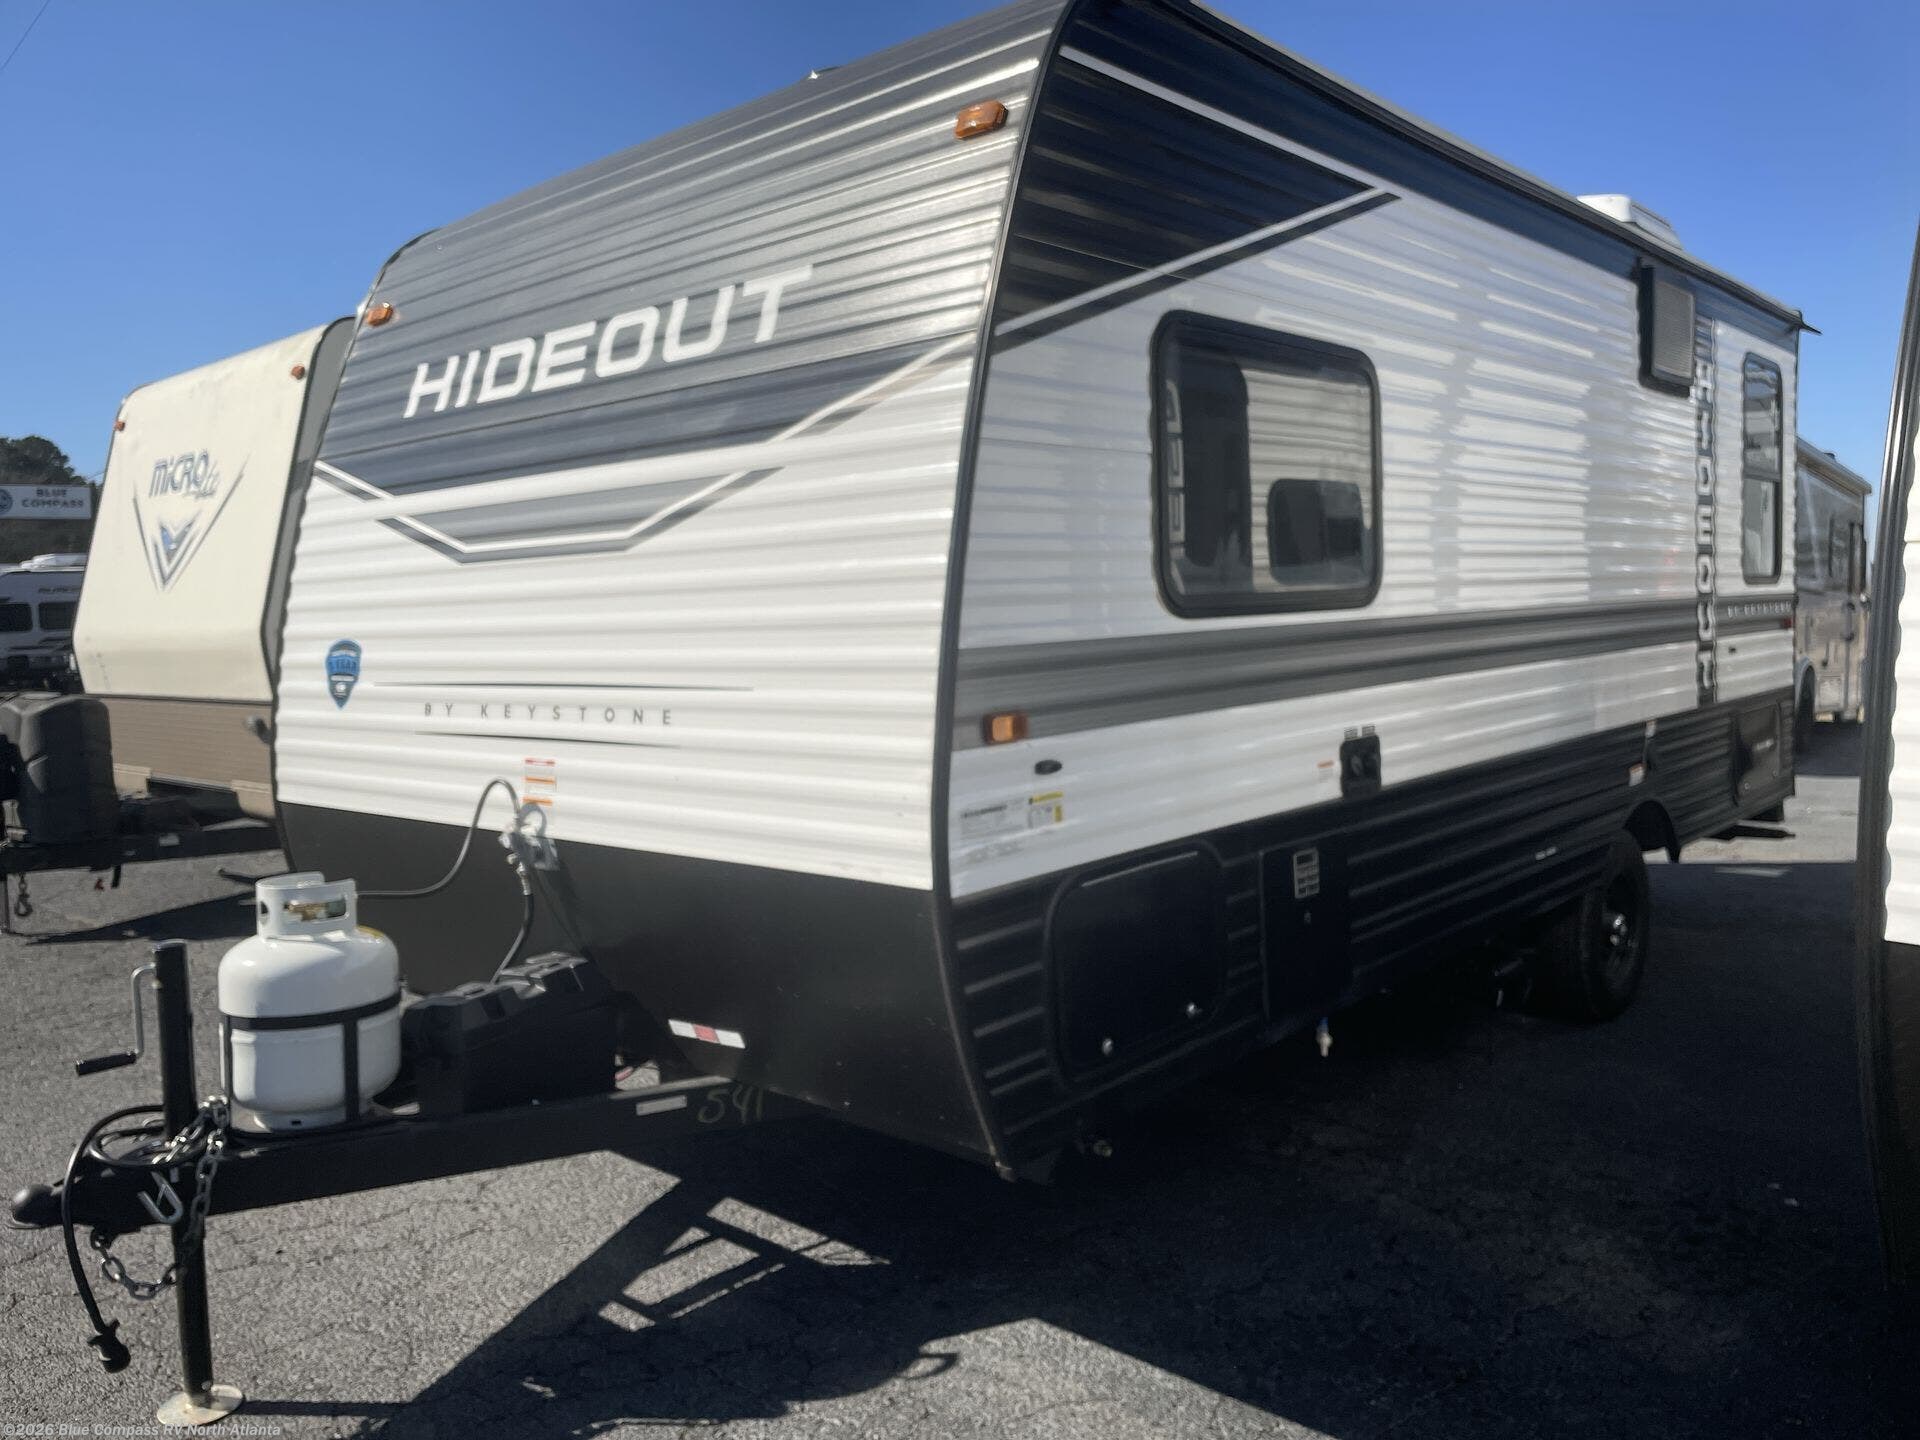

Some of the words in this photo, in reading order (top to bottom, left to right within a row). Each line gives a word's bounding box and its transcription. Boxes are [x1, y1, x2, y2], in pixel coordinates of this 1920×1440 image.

[403, 264, 813, 419] HIDEOUT
[21, 499, 84, 509] COMPASS
[424, 703, 453, 716] BY
[480, 703, 672, 726] KEYSTONE
